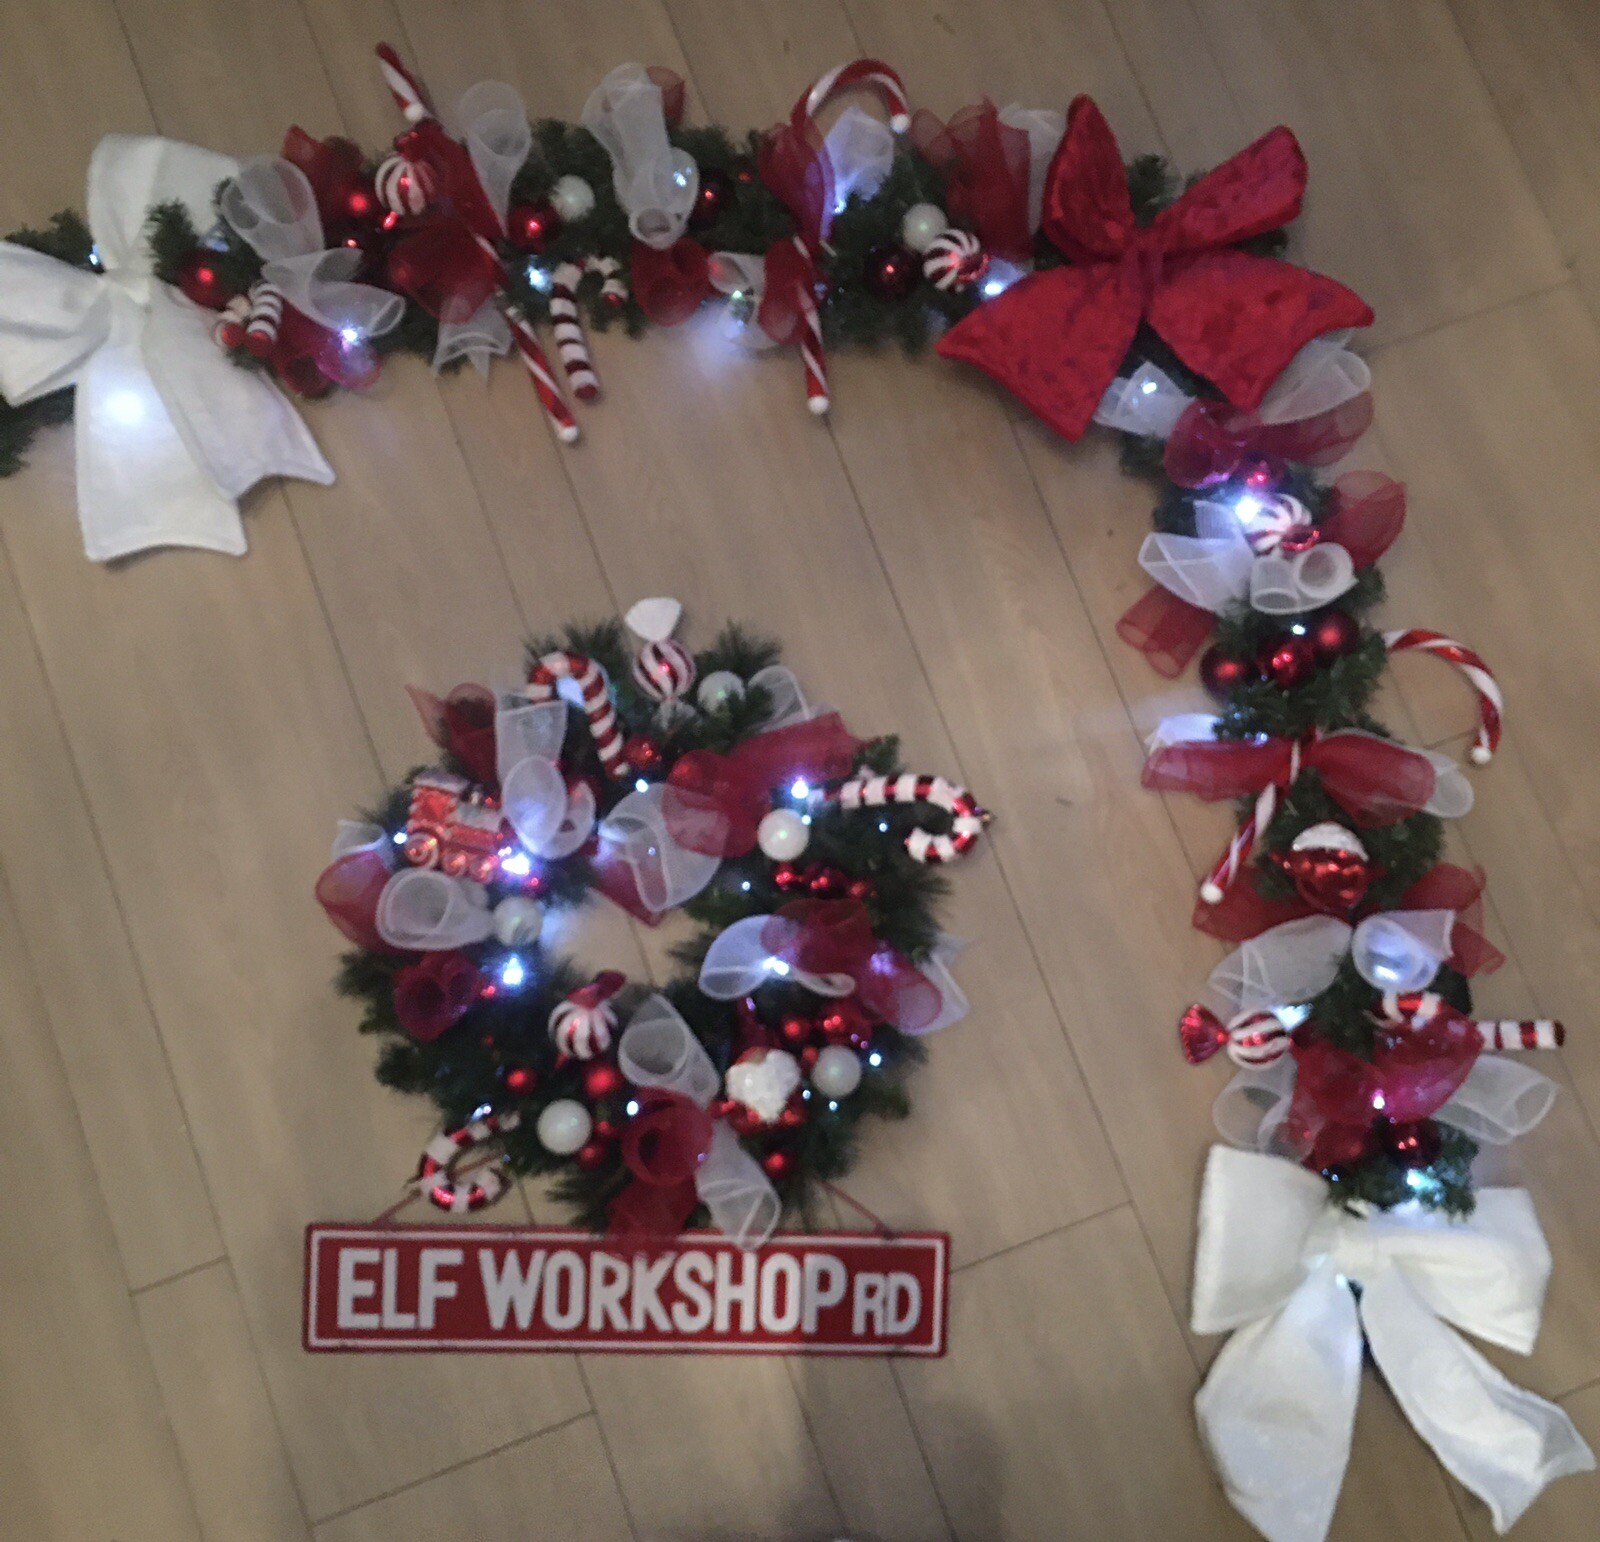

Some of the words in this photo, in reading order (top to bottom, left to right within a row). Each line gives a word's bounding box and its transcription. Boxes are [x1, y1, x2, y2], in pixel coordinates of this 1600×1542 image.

[336, 1247, 464, 1329] ELF
[478, 1248, 847, 1334] WORKSHOP
[852, 1272, 921, 1335] RD
